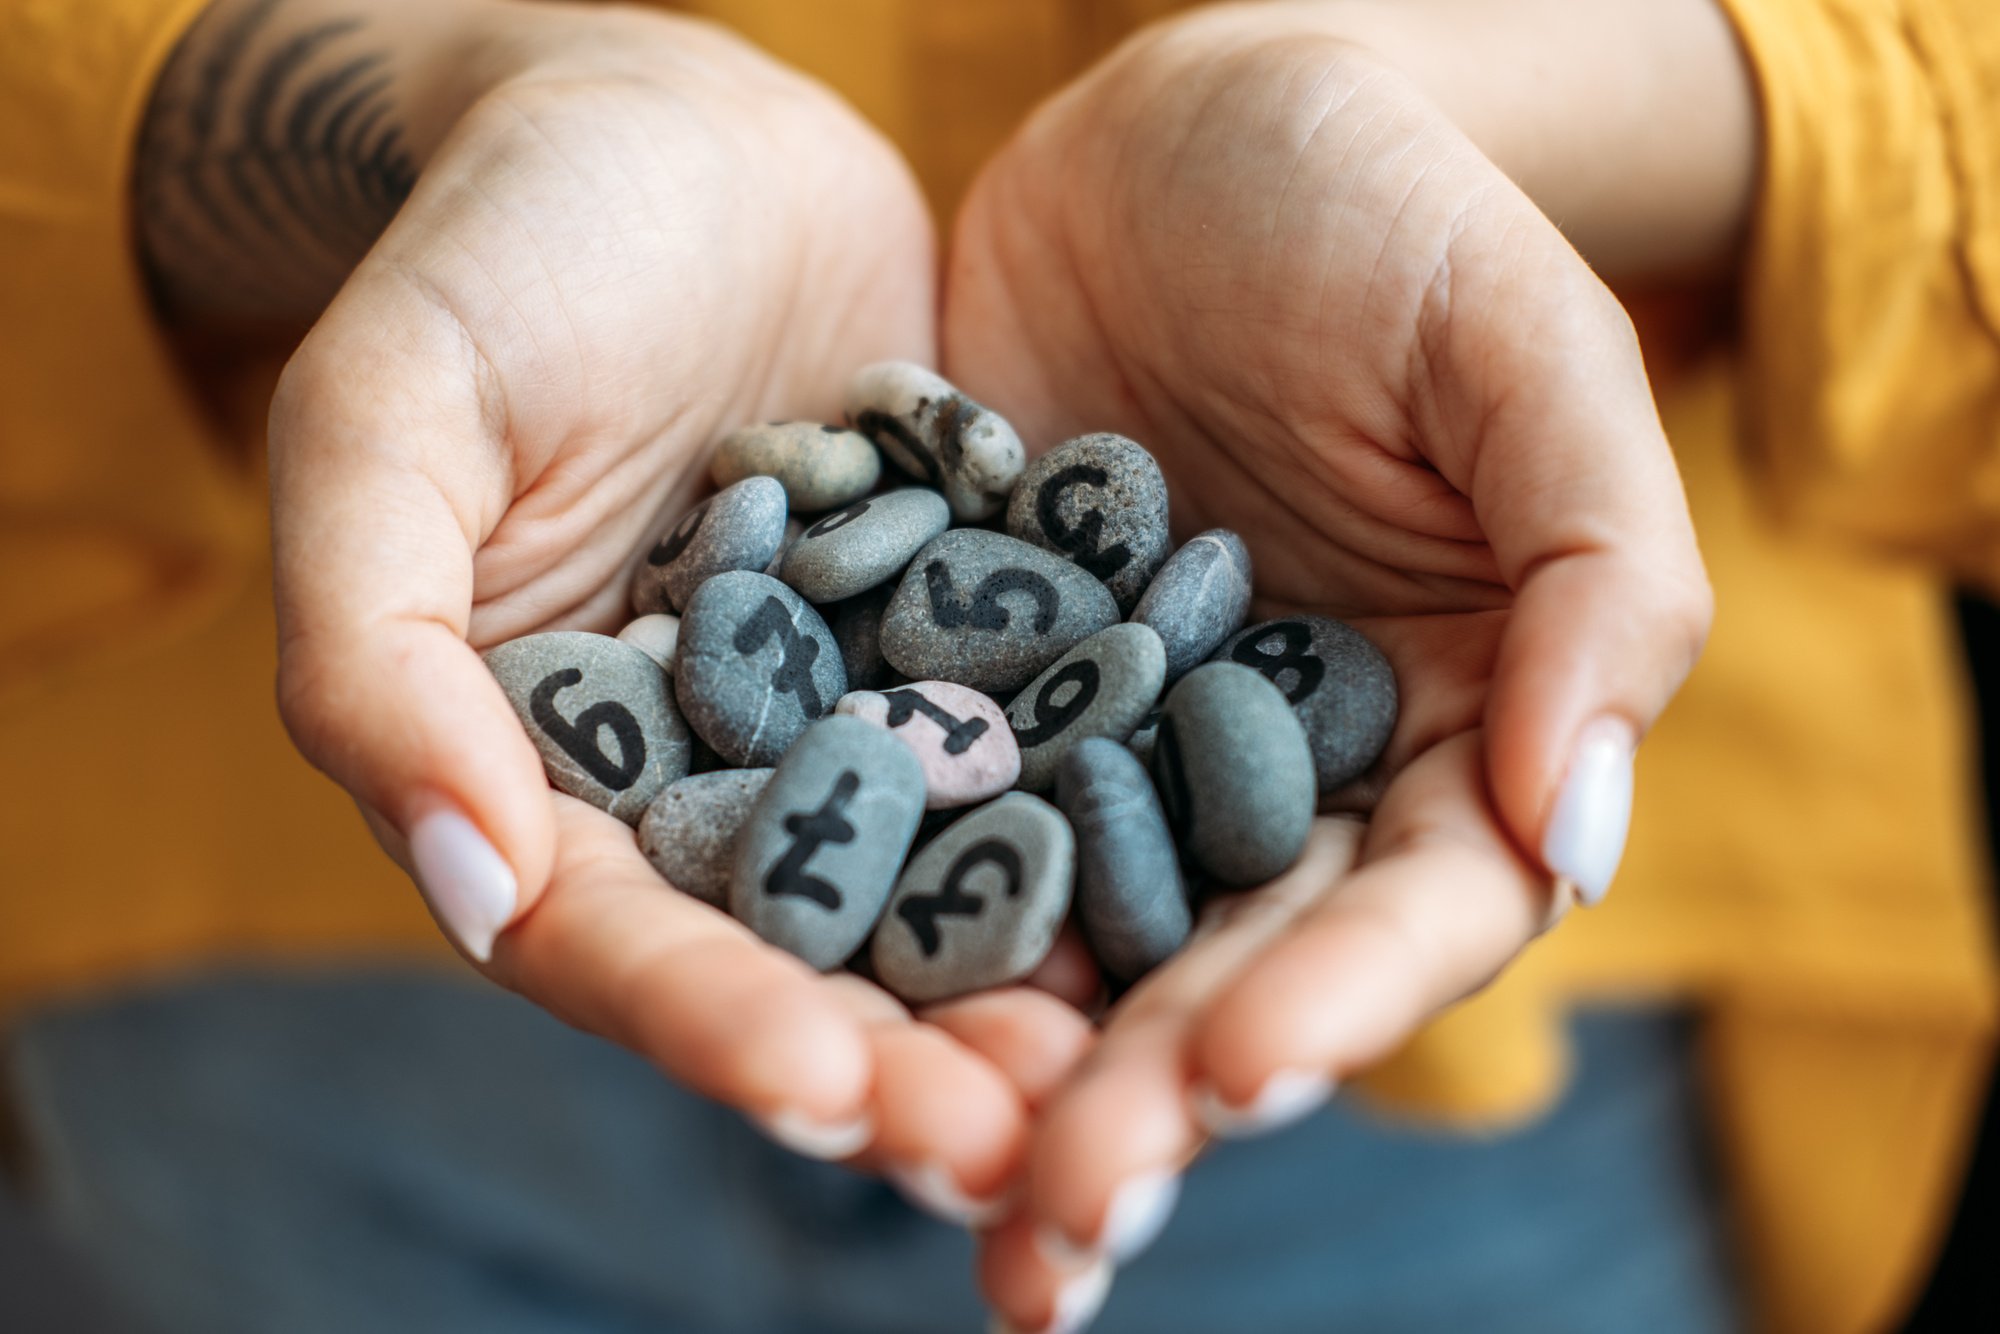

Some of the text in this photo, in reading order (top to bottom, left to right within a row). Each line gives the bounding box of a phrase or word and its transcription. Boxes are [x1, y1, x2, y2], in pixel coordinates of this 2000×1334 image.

[924, 558, 1060, 635] 5
[733, 595, 822, 720] 7
[1230, 620, 1326, 705] 8
[885, 688, 990, 755] 1
[765, 770, 860, 910] 7
